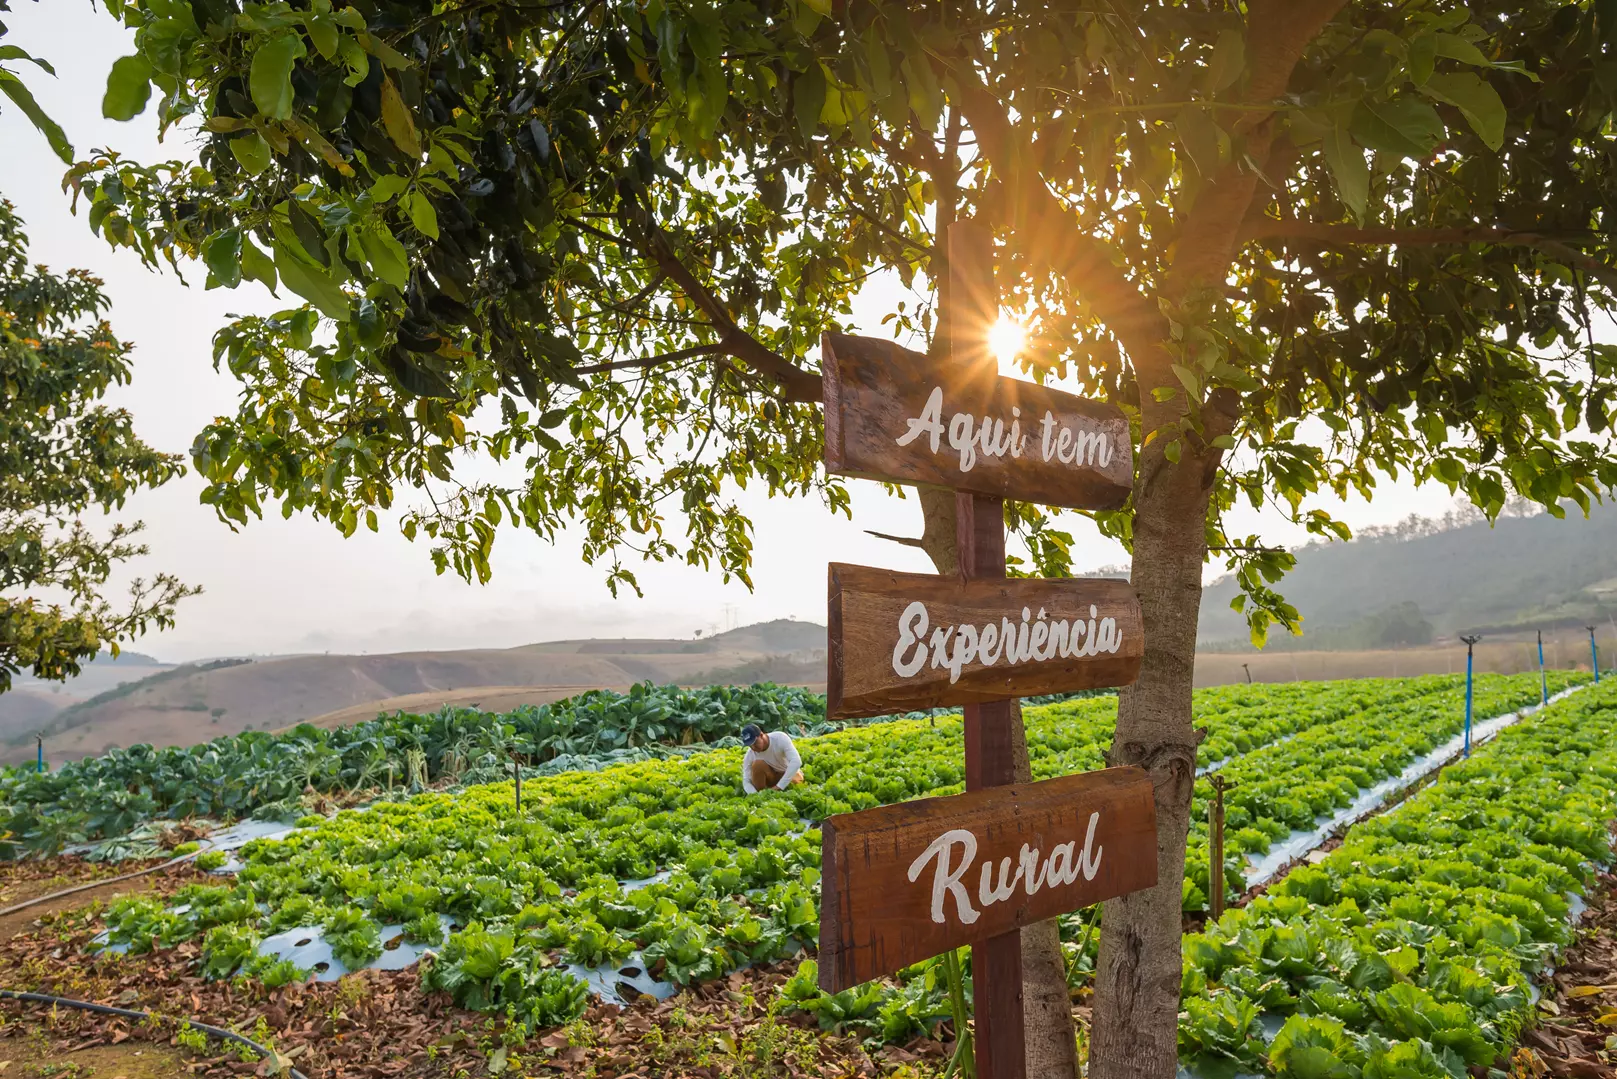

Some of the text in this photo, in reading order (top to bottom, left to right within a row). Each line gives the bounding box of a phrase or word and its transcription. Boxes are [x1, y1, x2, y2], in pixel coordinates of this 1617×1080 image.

[895, 386, 1113, 473] Aqui tem
[892, 601, 1123, 685] Experiência
[907, 811, 1103, 925] Rural
